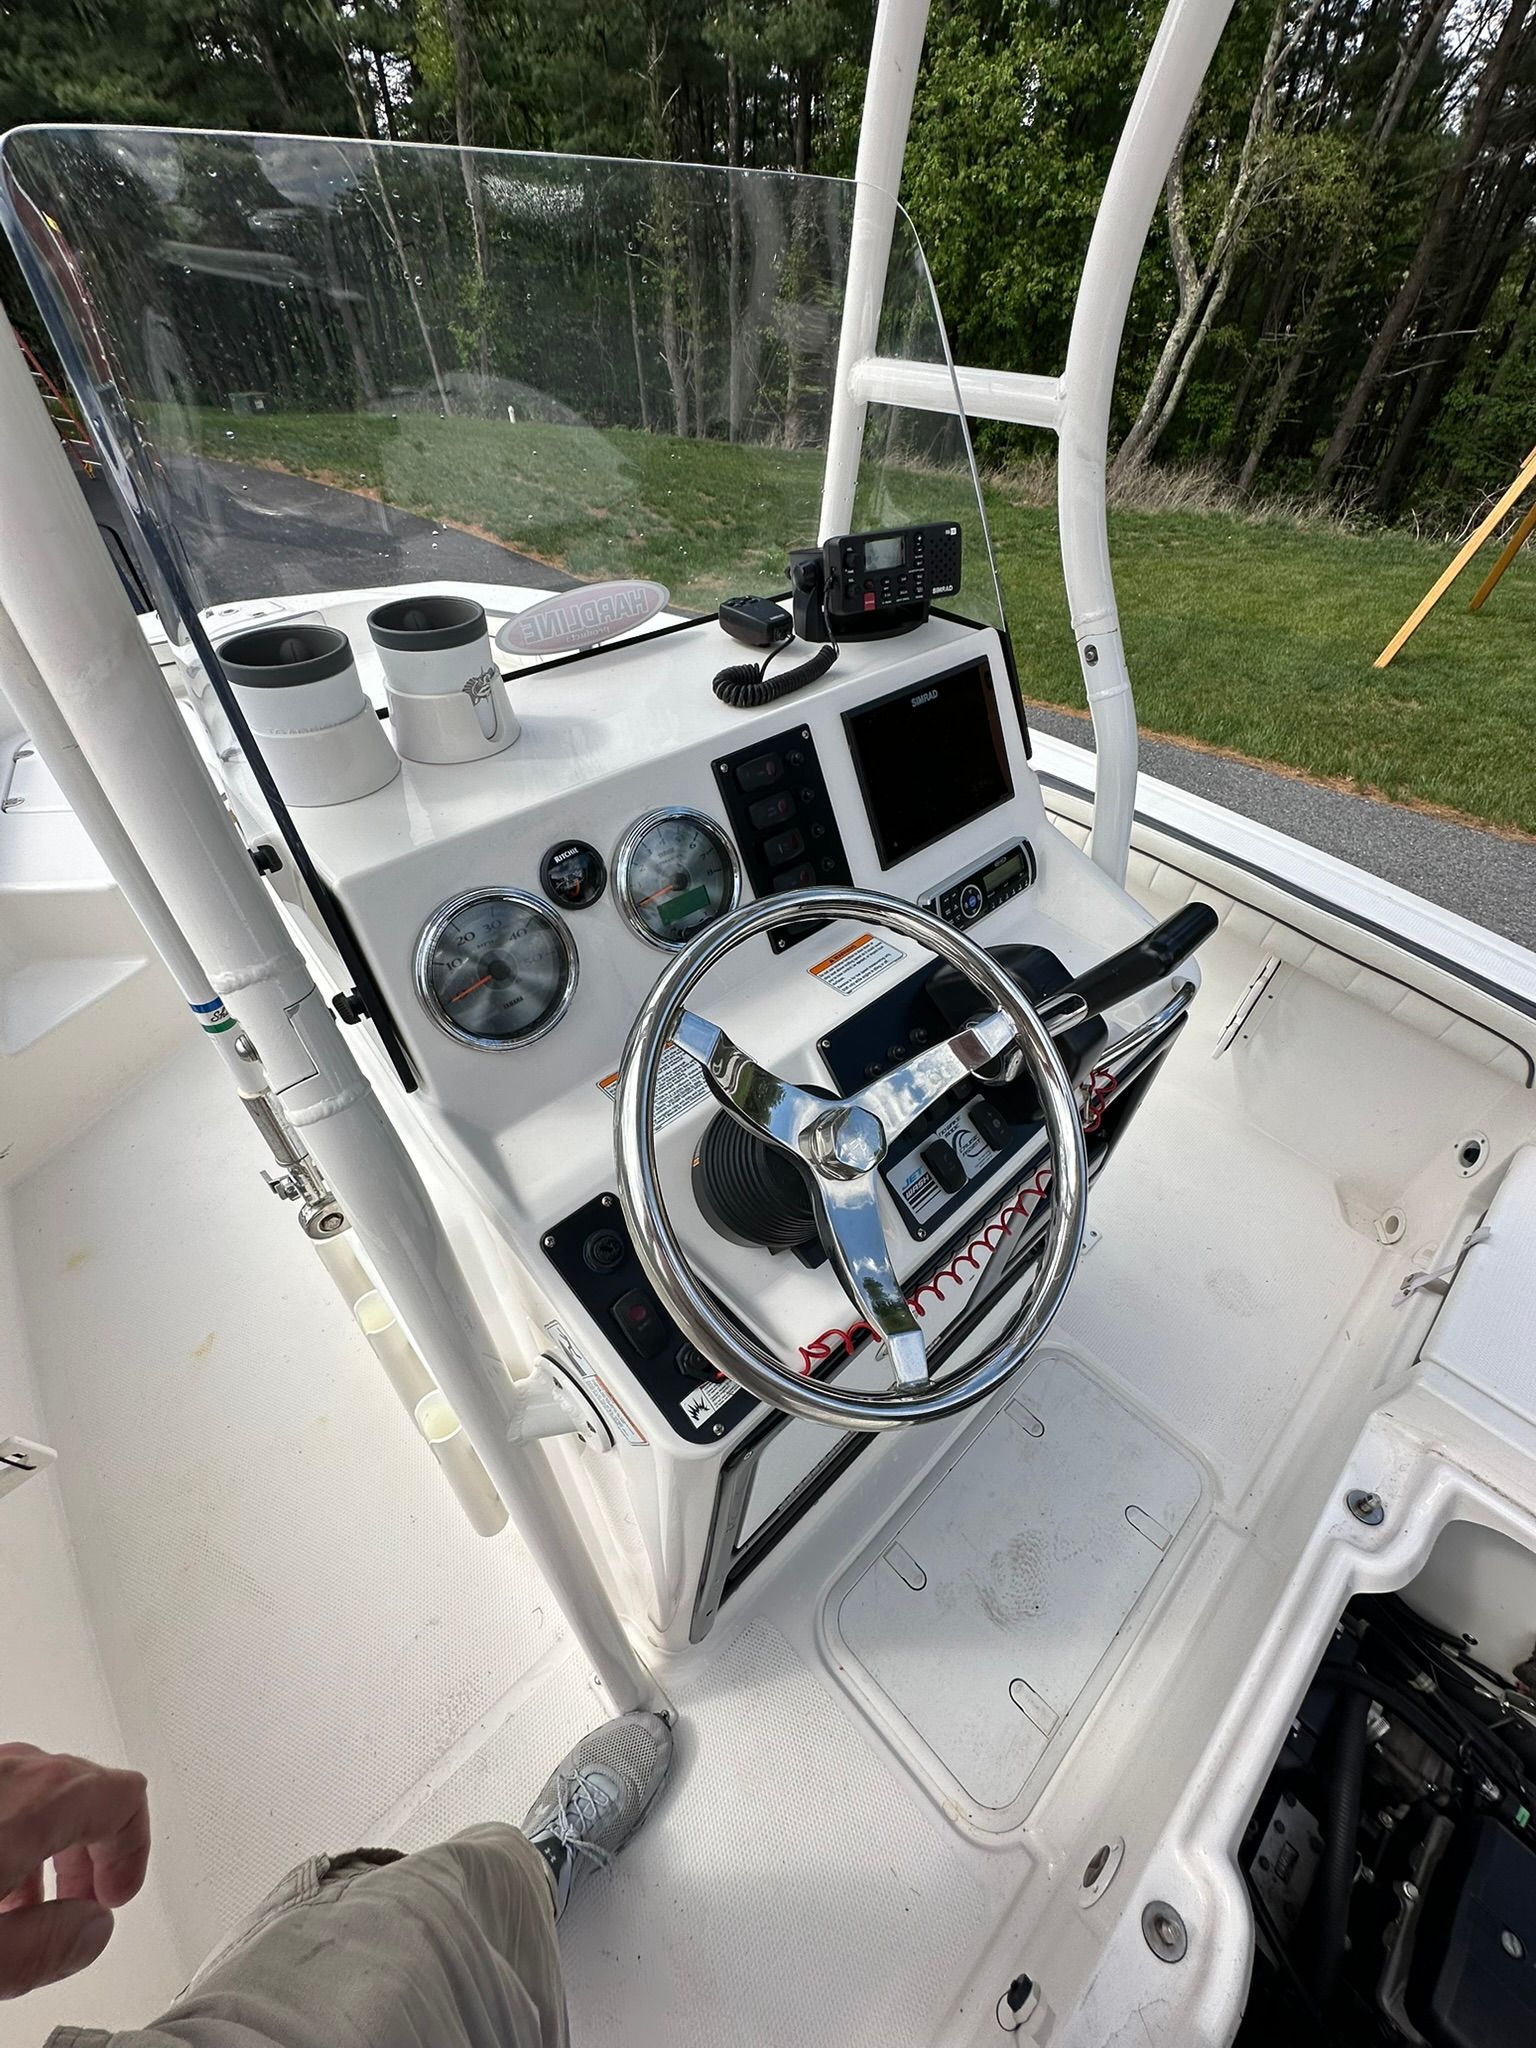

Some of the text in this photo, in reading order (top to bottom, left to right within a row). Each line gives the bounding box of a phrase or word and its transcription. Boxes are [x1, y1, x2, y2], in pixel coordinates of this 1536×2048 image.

[932, 584, 954, 595] SIMRAD
[911, 689, 939, 708] SIMRAD
[553, 847, 580, 864] RITCHIE
[482, 919, 502, 932] 30
[456, 931, 476, 946] 20
[508, 927, 527, 942] 40
[446, 957, 464, 971] 10
[902, 1167, 925, 1190] JET
[905, 1174, 931, 1199] WASH
